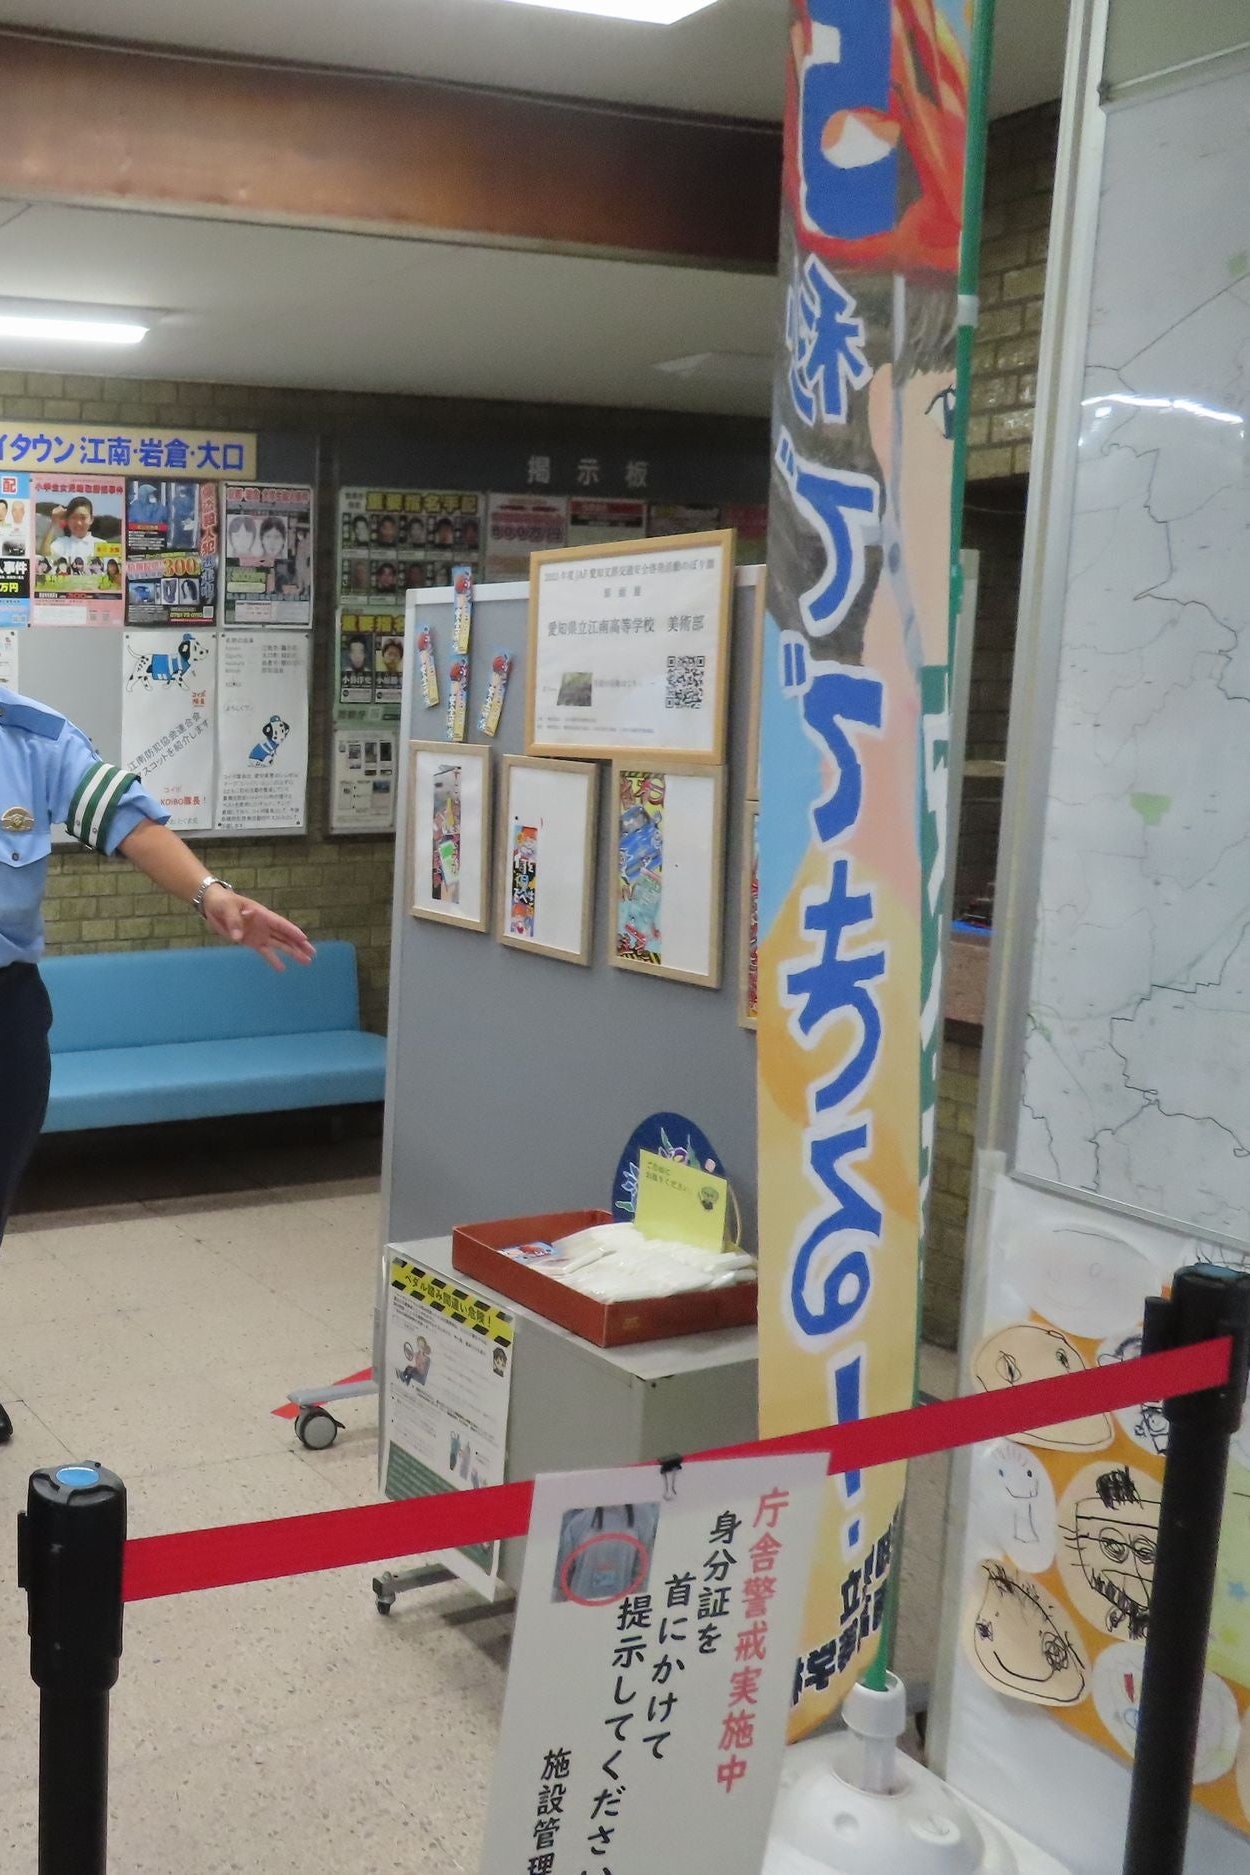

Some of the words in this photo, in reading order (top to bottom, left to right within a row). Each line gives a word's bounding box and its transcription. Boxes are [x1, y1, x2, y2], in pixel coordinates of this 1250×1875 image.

[527, 456, 649, 487] 掲示板
[163, 557, 199, 577] 300
[547, 616, 655, 637] 愛知県立江南高等学校
[667, 615, 706, 633] 美術部
[128, 711, 201, 772] 江南防犯協会連合会
[697, 1510, 742, 1655] 身分証を
[642, 1572, 696, 1760] 首にかけて
[717, 1486, 790, 1793] 庁舎警戒実施中
